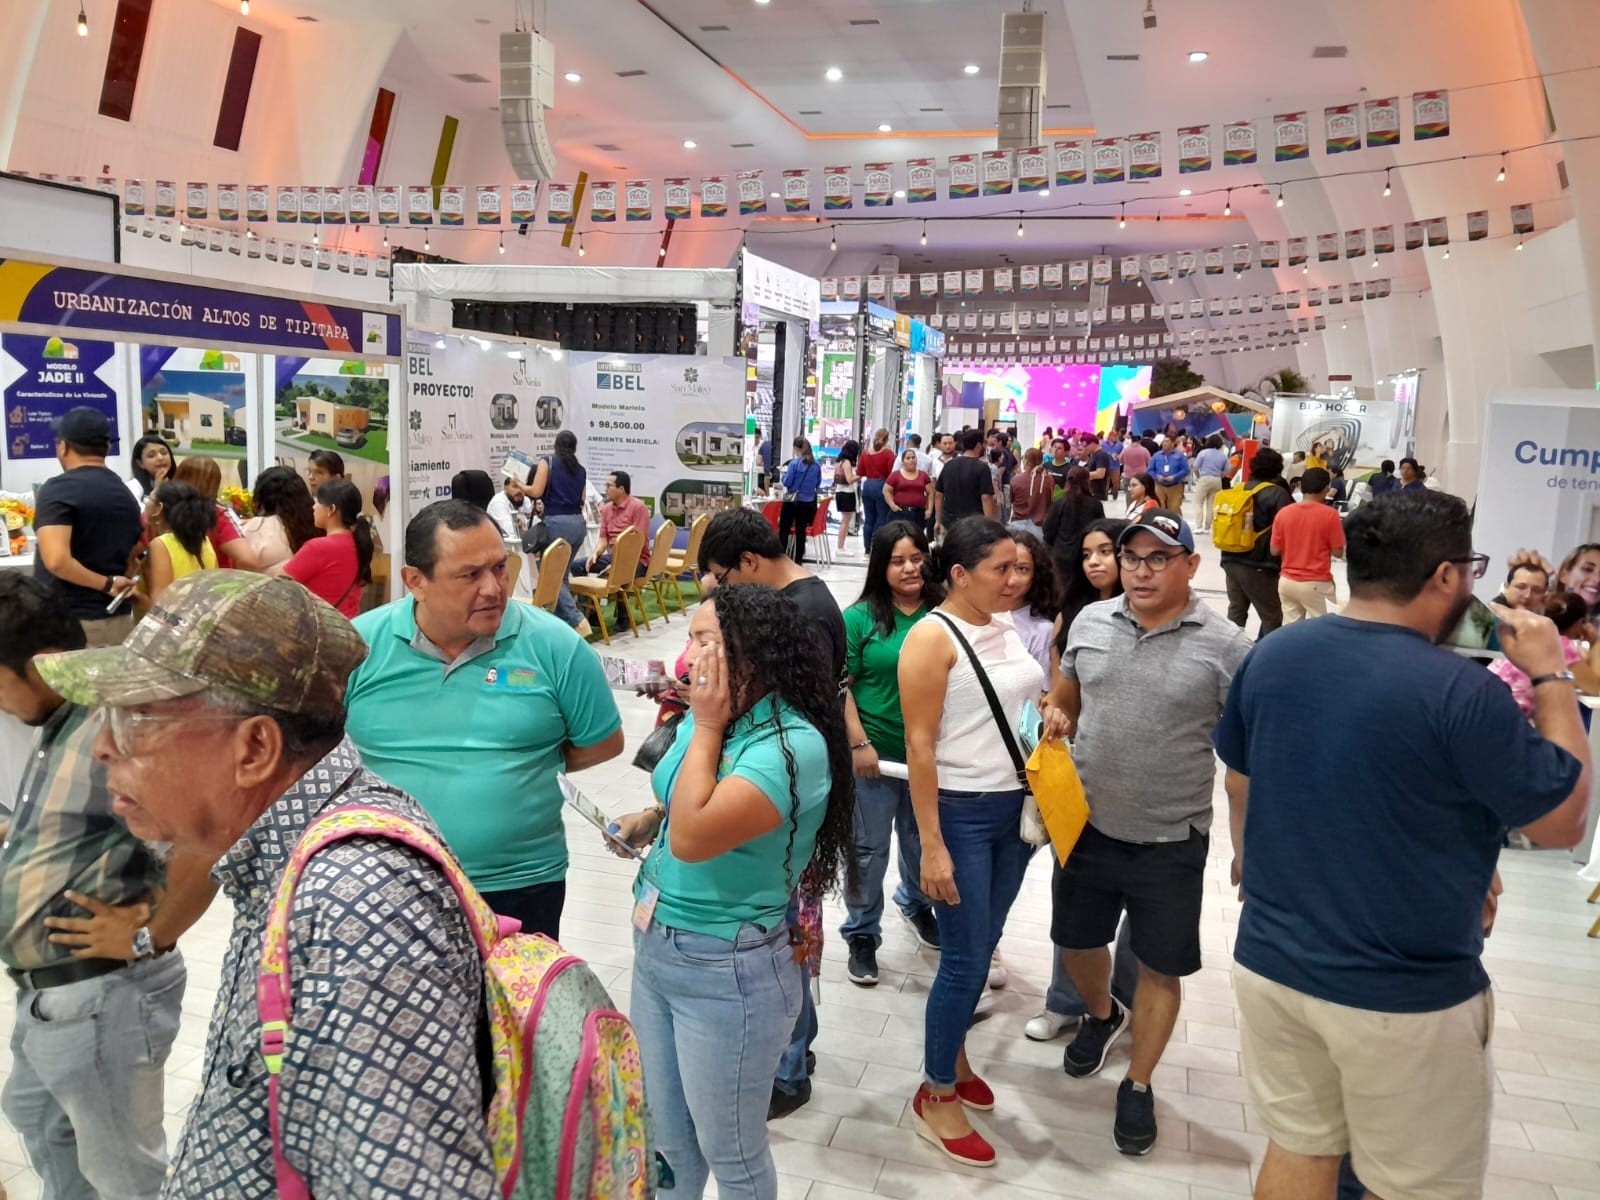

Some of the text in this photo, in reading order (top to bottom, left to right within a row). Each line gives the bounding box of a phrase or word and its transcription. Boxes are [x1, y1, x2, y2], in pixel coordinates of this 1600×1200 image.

[53, 291, 350, 340] URBANIZACIÓN ALTOS DE TIPITAPA
[409, 356, 433, 376] BEL
[38, 371, 84, 384] JADE II
[613, 374, 645, 391] BEL
[413, 382, 474, 398] PROYECTO!
[670, 383, 686, 393] San
[1325, 403, 1367, 413] HOGR
[589, 420, 645, 430] $ 98,500.00
[588, 435, 623, 443] AMBIENTE
[408, 460, 451, 472] iamiento
[1547, 475, 1600, 491] de ten
